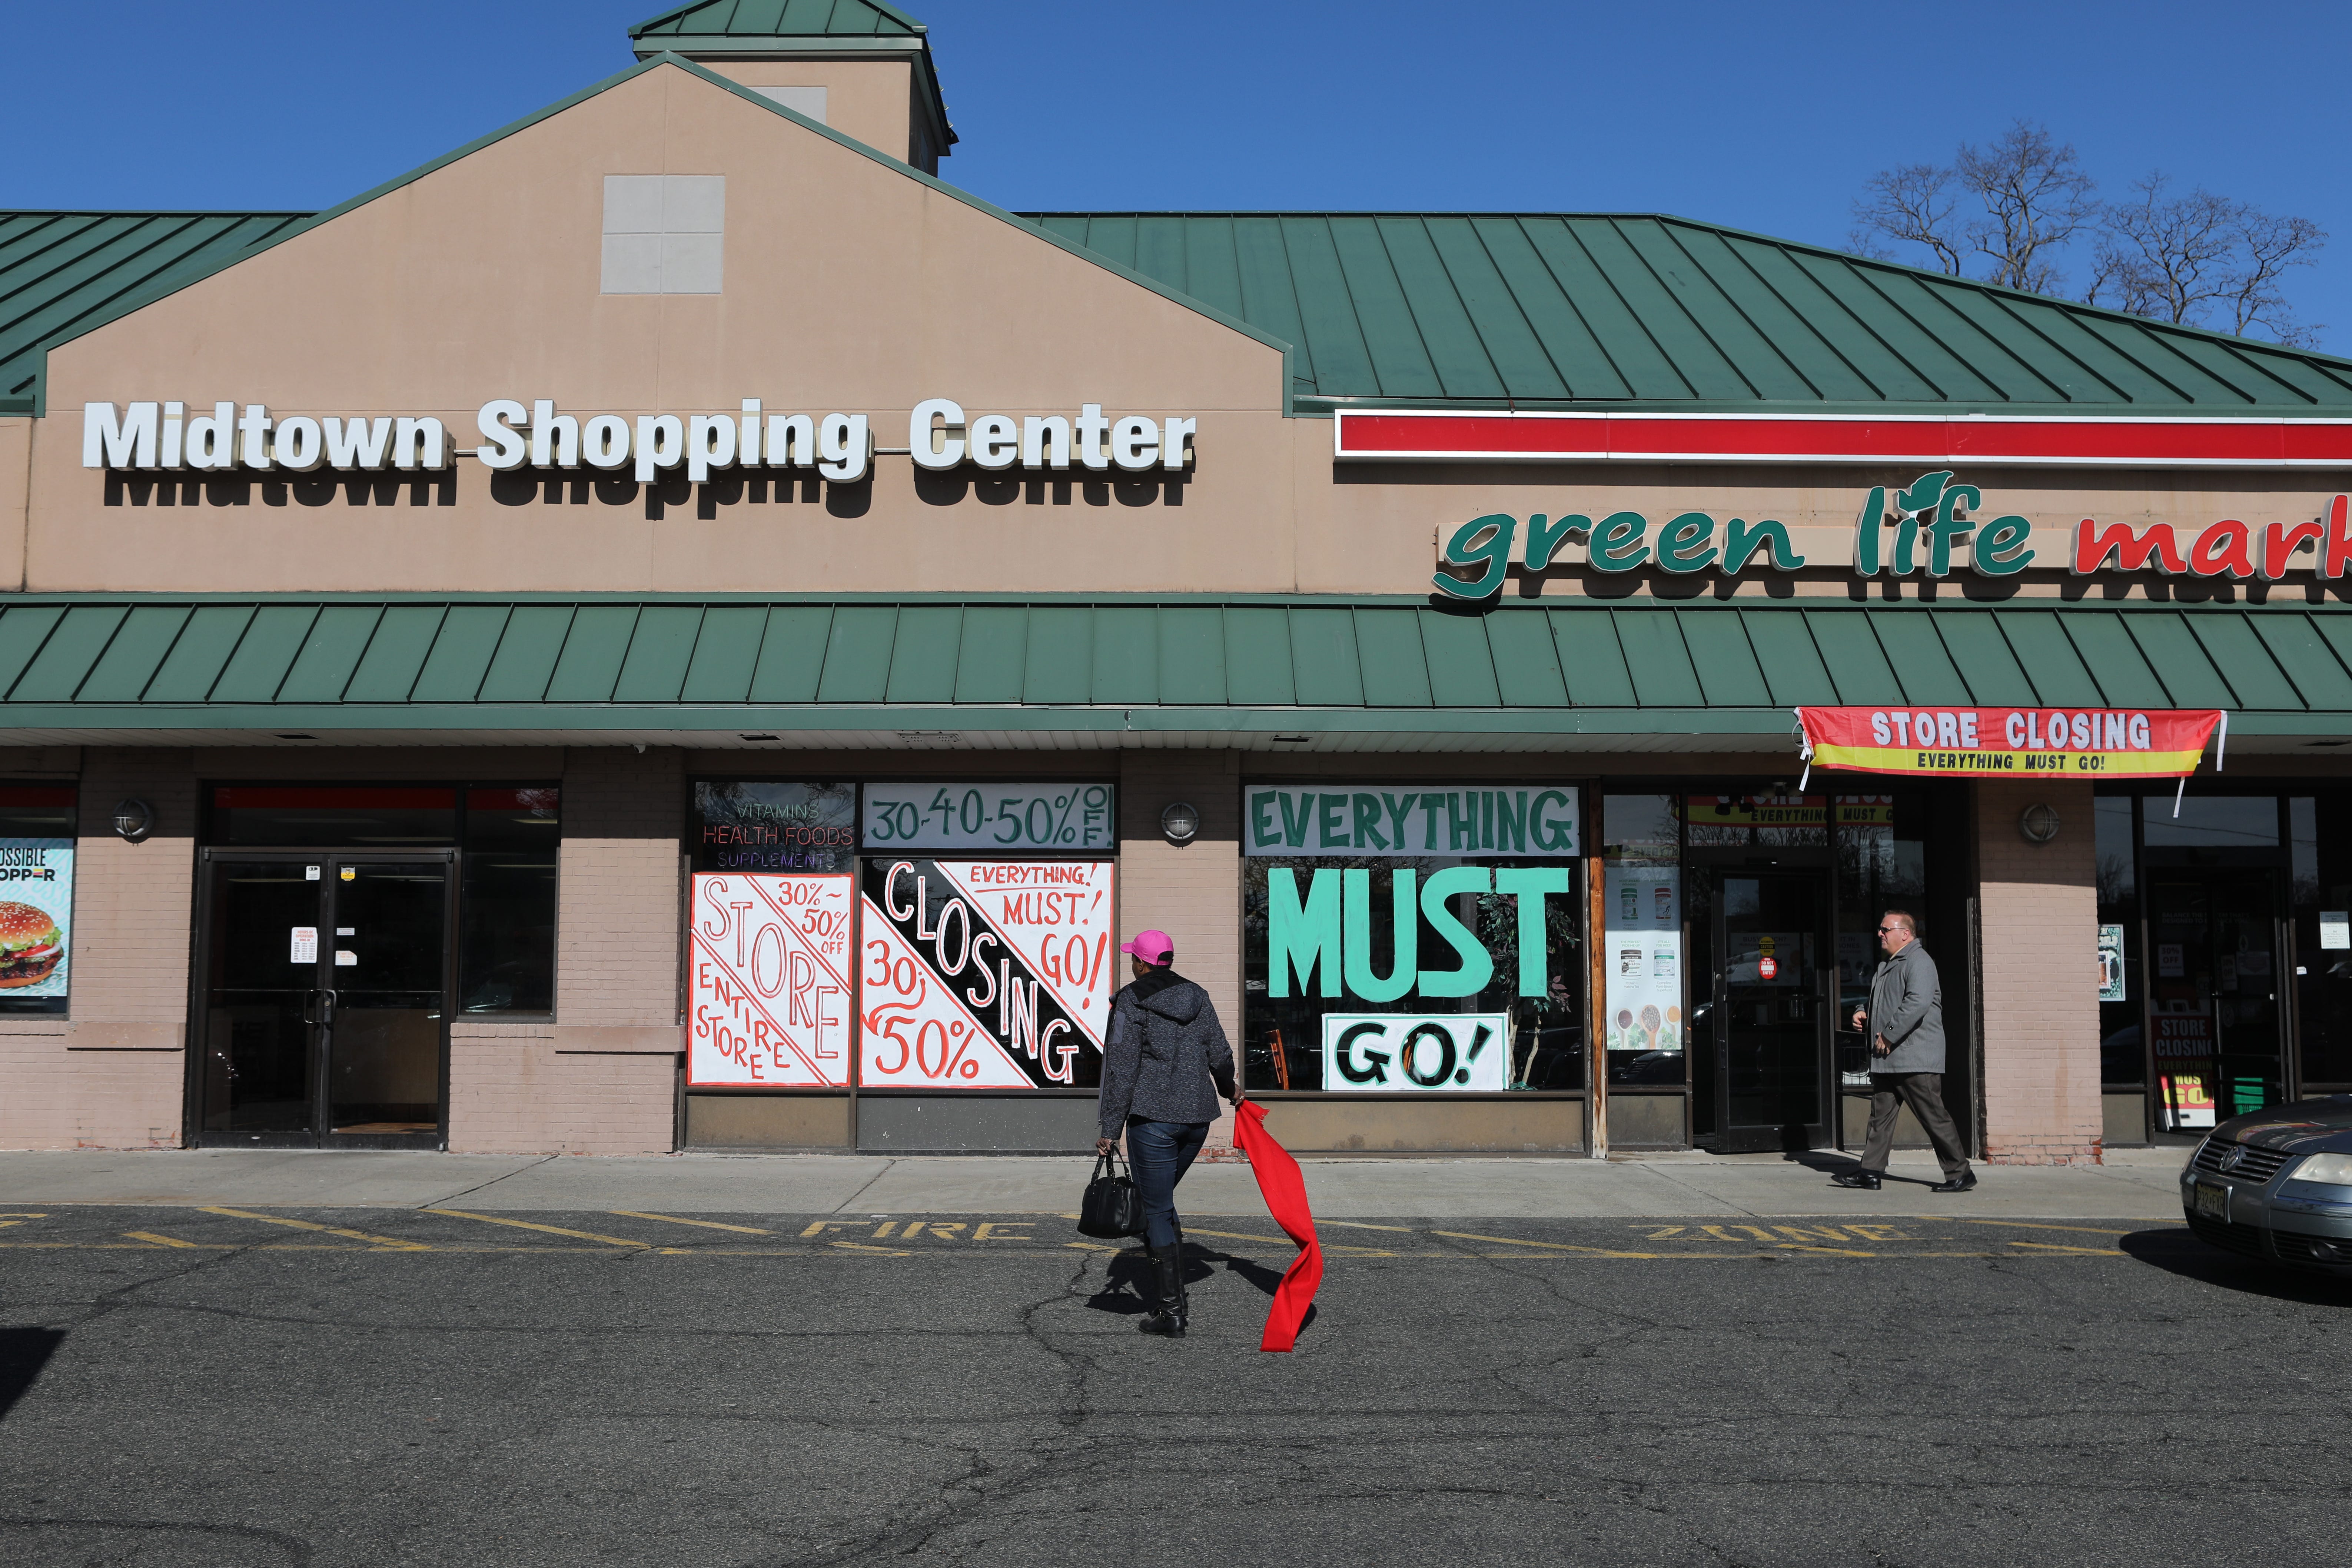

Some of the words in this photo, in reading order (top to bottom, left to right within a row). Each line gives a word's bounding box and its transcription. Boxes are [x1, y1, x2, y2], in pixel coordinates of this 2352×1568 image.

[82, 400, 448, 471] Midtown
[476, 398, 874, 484] Shopping
[910, 396, 1197, 471] Center
[1432, 511, 1805, 600] green
[1855, 470, 2036, 578] life
[1871, 711, 1979, 748] STORE
[2005, 712, 2152, 750] CLOSING
[1917, 752, 2013, 769] EVERYTHING
[2025, 754, 2066, 770] MUST
[2079, 754, 2105, 770] GO!
[737, 804, 820, 818] VITAMINS
[1251, 790, 1573, 853] EVERYTHING
[1843, 808, 1876, 820] MUST
[703, 825, 778, 845] HEALTH
[785, 827, 853, 845] FOODS
[717, 853, 836, 868] SUPPLEMENTS
[970, 863, 1097, 887] EVERYTHING!
[802, 908, 848, 940] 50%
[1003, 890, 1103, 926] MUST!
[821, 941, 844, 954] OFF
[1268, 866, 1570, 1003] MUST
[704, 876, 838, 1059] STORE
[885, 861, 1080, 1084] CLOSING
[1040, 931, 1107, 1010] GO!
[699, 963, 790, 1069] ENTIRE
[2161, 1019, 2207, 1036] STORE
[696, 1005, 764, 1080] STORE
[876, 1015, 979, 1080] 50%
[1334, 1020, 1495, 1089] GO!
[2172, 1073, 2209, 1085] MUST
[800, 1220, 1037, 1241] FIRE
[1628, 1224, 1928, 1242] ZONE
